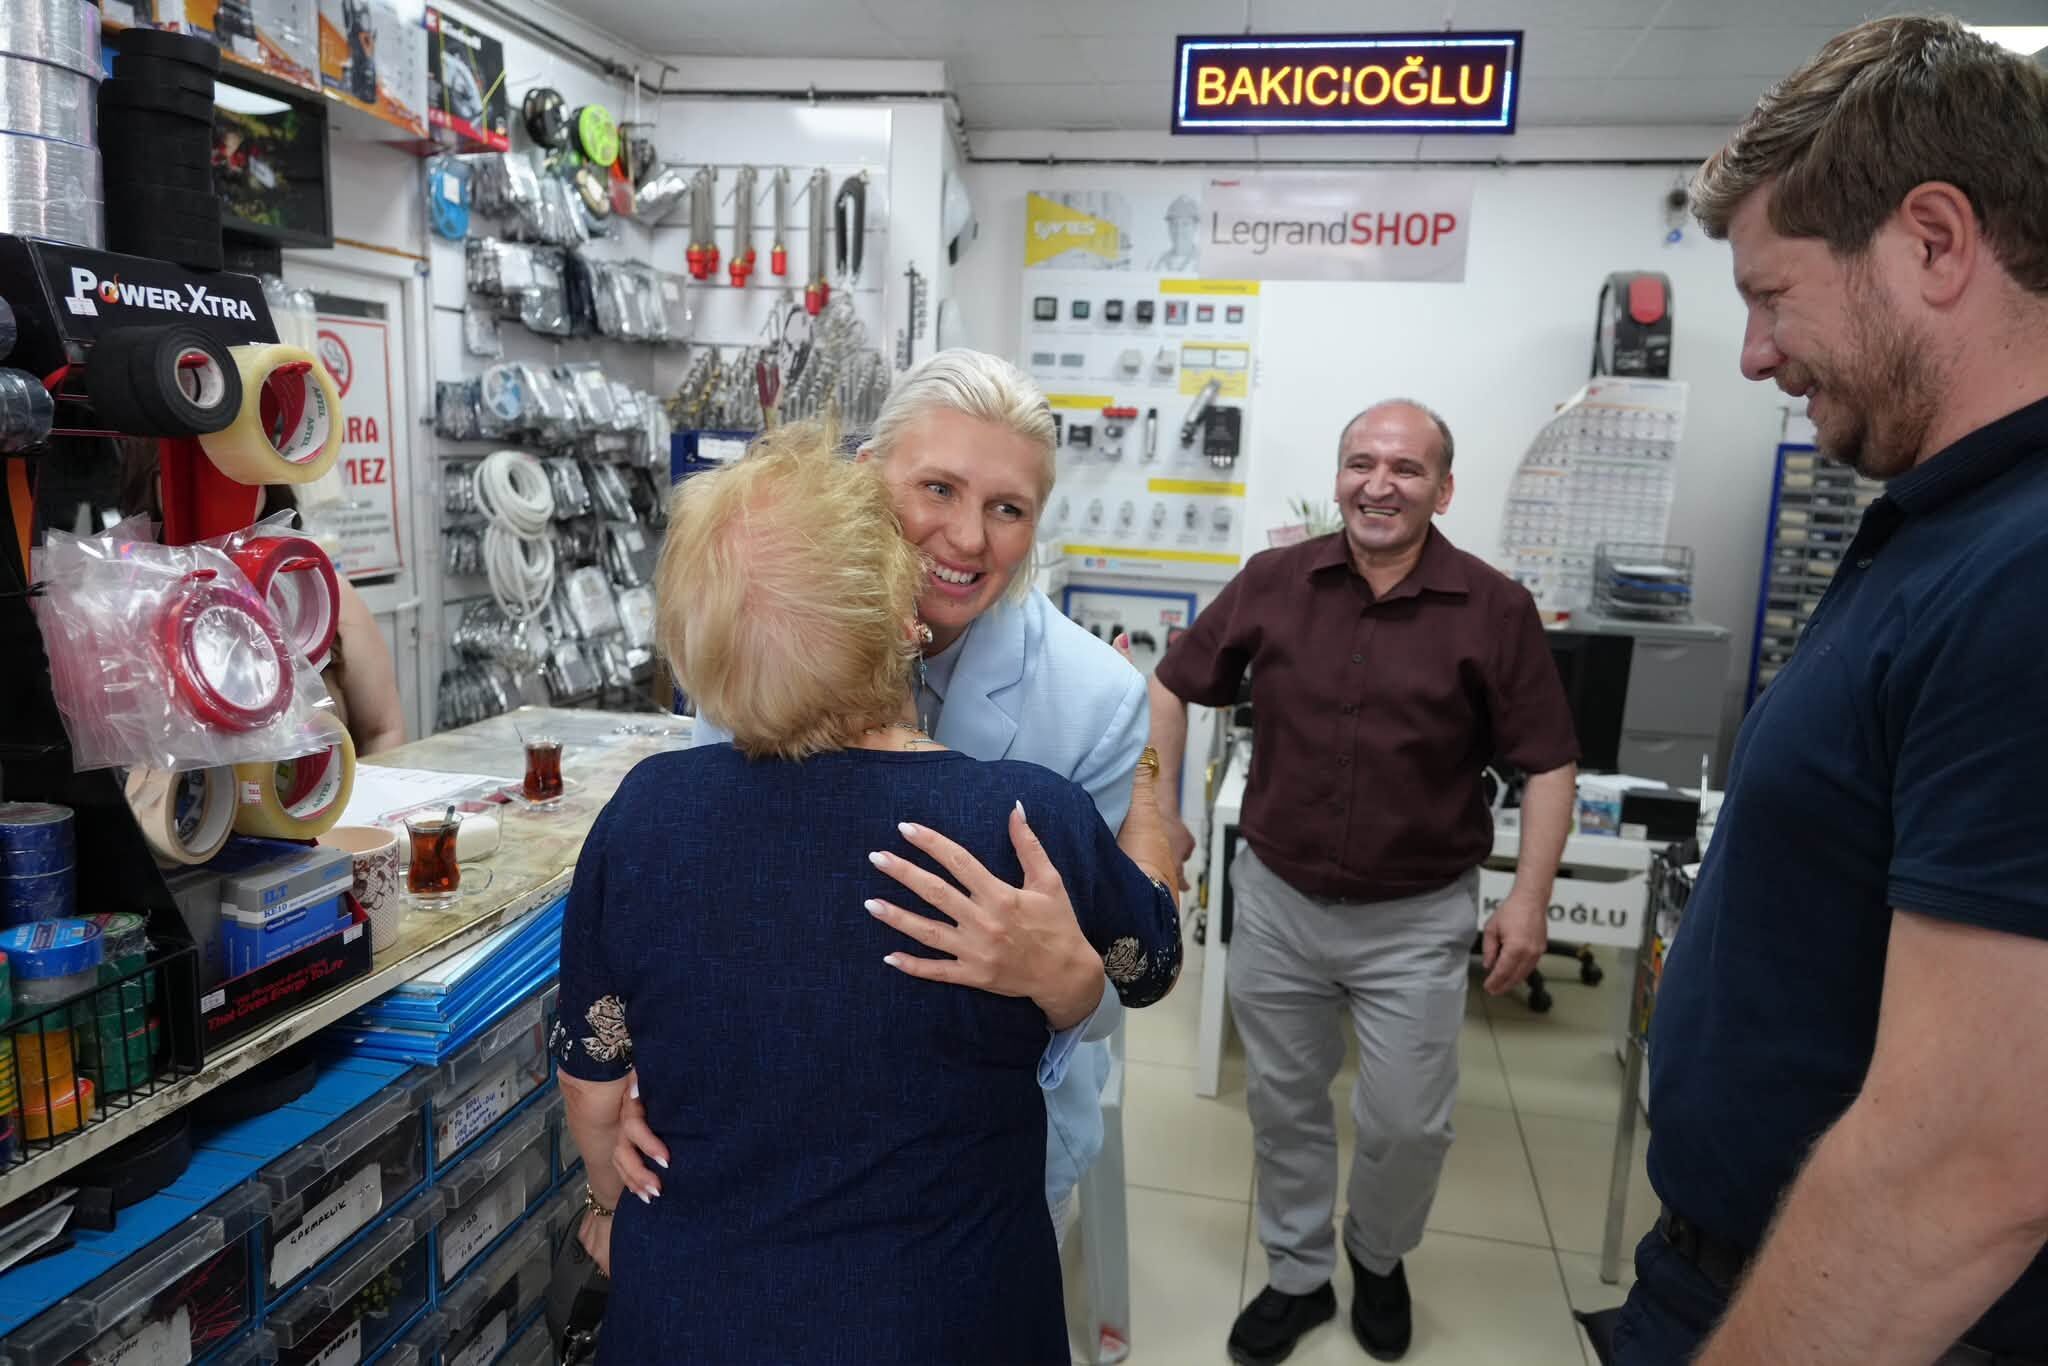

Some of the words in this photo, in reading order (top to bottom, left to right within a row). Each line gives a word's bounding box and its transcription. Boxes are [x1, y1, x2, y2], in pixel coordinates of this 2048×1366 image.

[1196, 56, 1495, 106] BAKICIOĞLU
[1211, 211, 1458, 255] LegrandSHOP
[342, 416, 380, 444] RA
